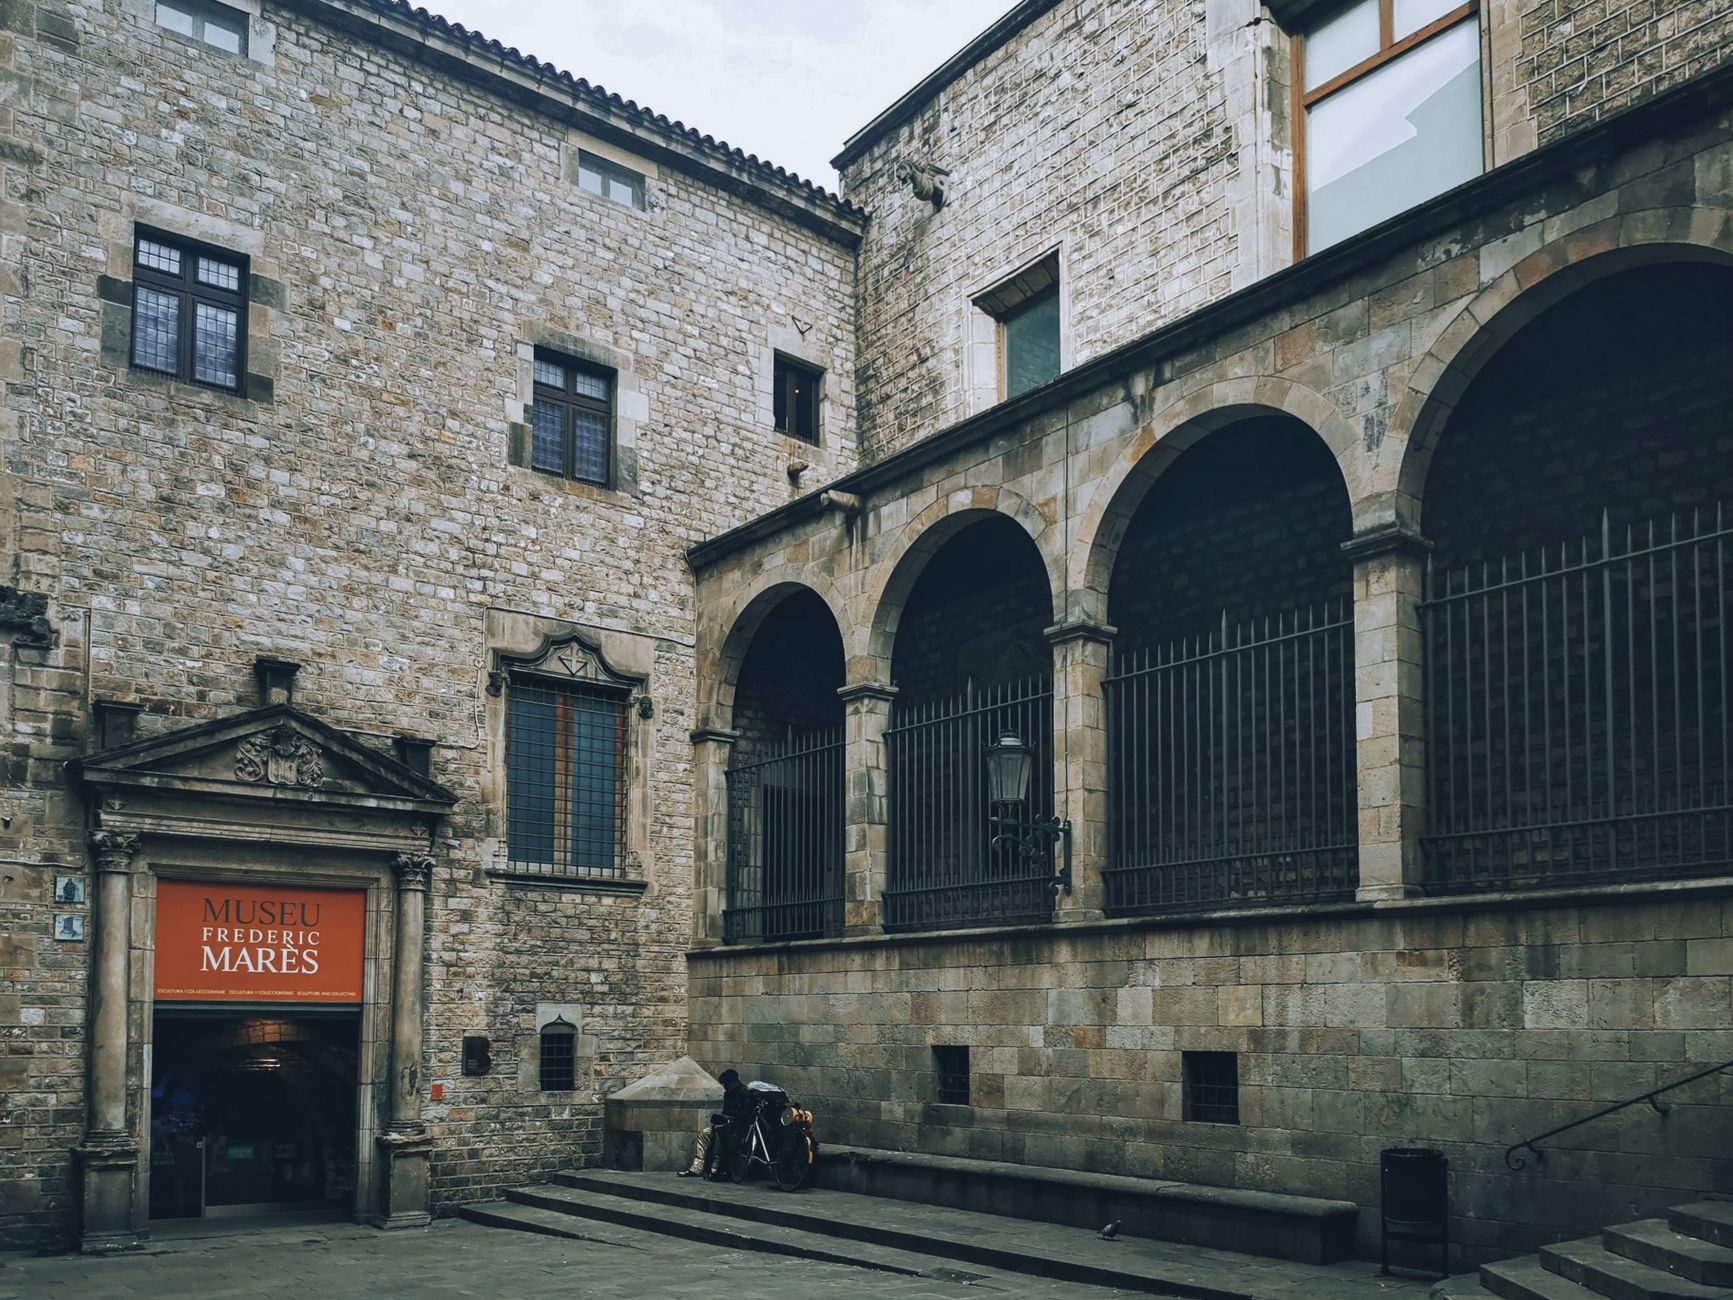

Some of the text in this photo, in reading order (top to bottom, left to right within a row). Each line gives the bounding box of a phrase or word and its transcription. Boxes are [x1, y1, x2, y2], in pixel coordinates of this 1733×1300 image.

[203, 897, 323, 927] MUSEU
[202, 927, 320, 946] FREDERIC
[200, 943, 319, 974] MARÈS
